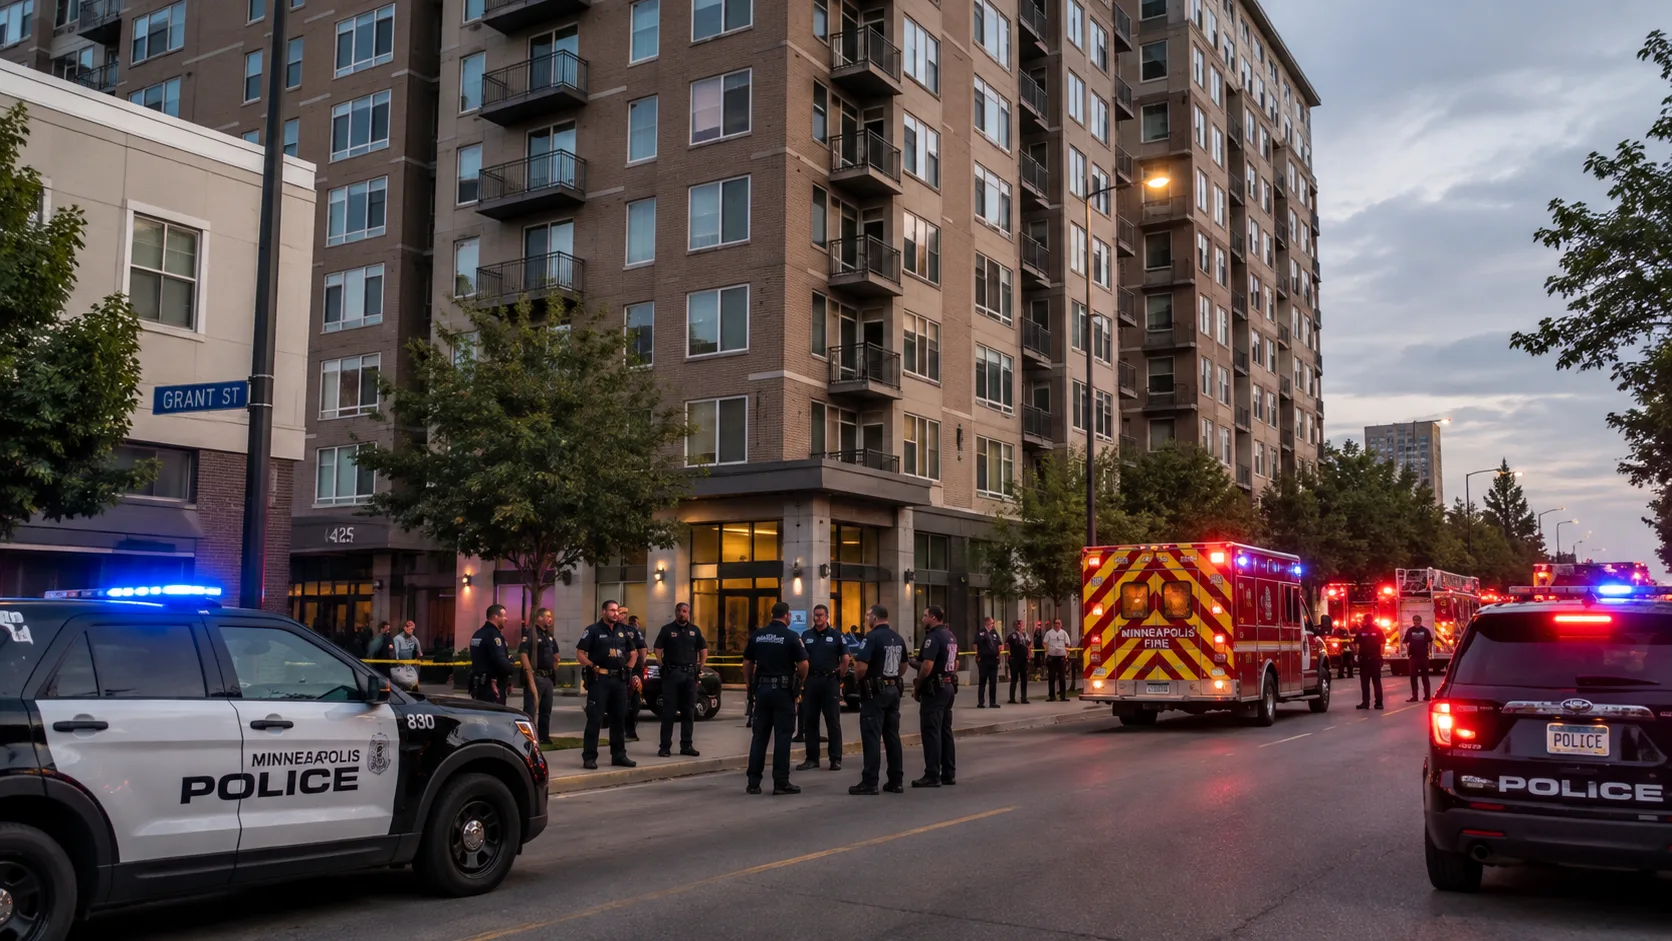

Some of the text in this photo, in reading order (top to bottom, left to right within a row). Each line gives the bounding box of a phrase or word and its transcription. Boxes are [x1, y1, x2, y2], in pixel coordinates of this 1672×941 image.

[163, 386, 240, 409] GRANT ST
[1121, 627, 1195, 638] MINNEAPOLIS
[1144, 638, 1169, 649] FIRE
[407, 713, 435, 730] 830
[1553, 732, 1603, 749] POLICE
[180, 767, 359, 804] POLICE
[1499, 776, 1664, 802] POLICE
